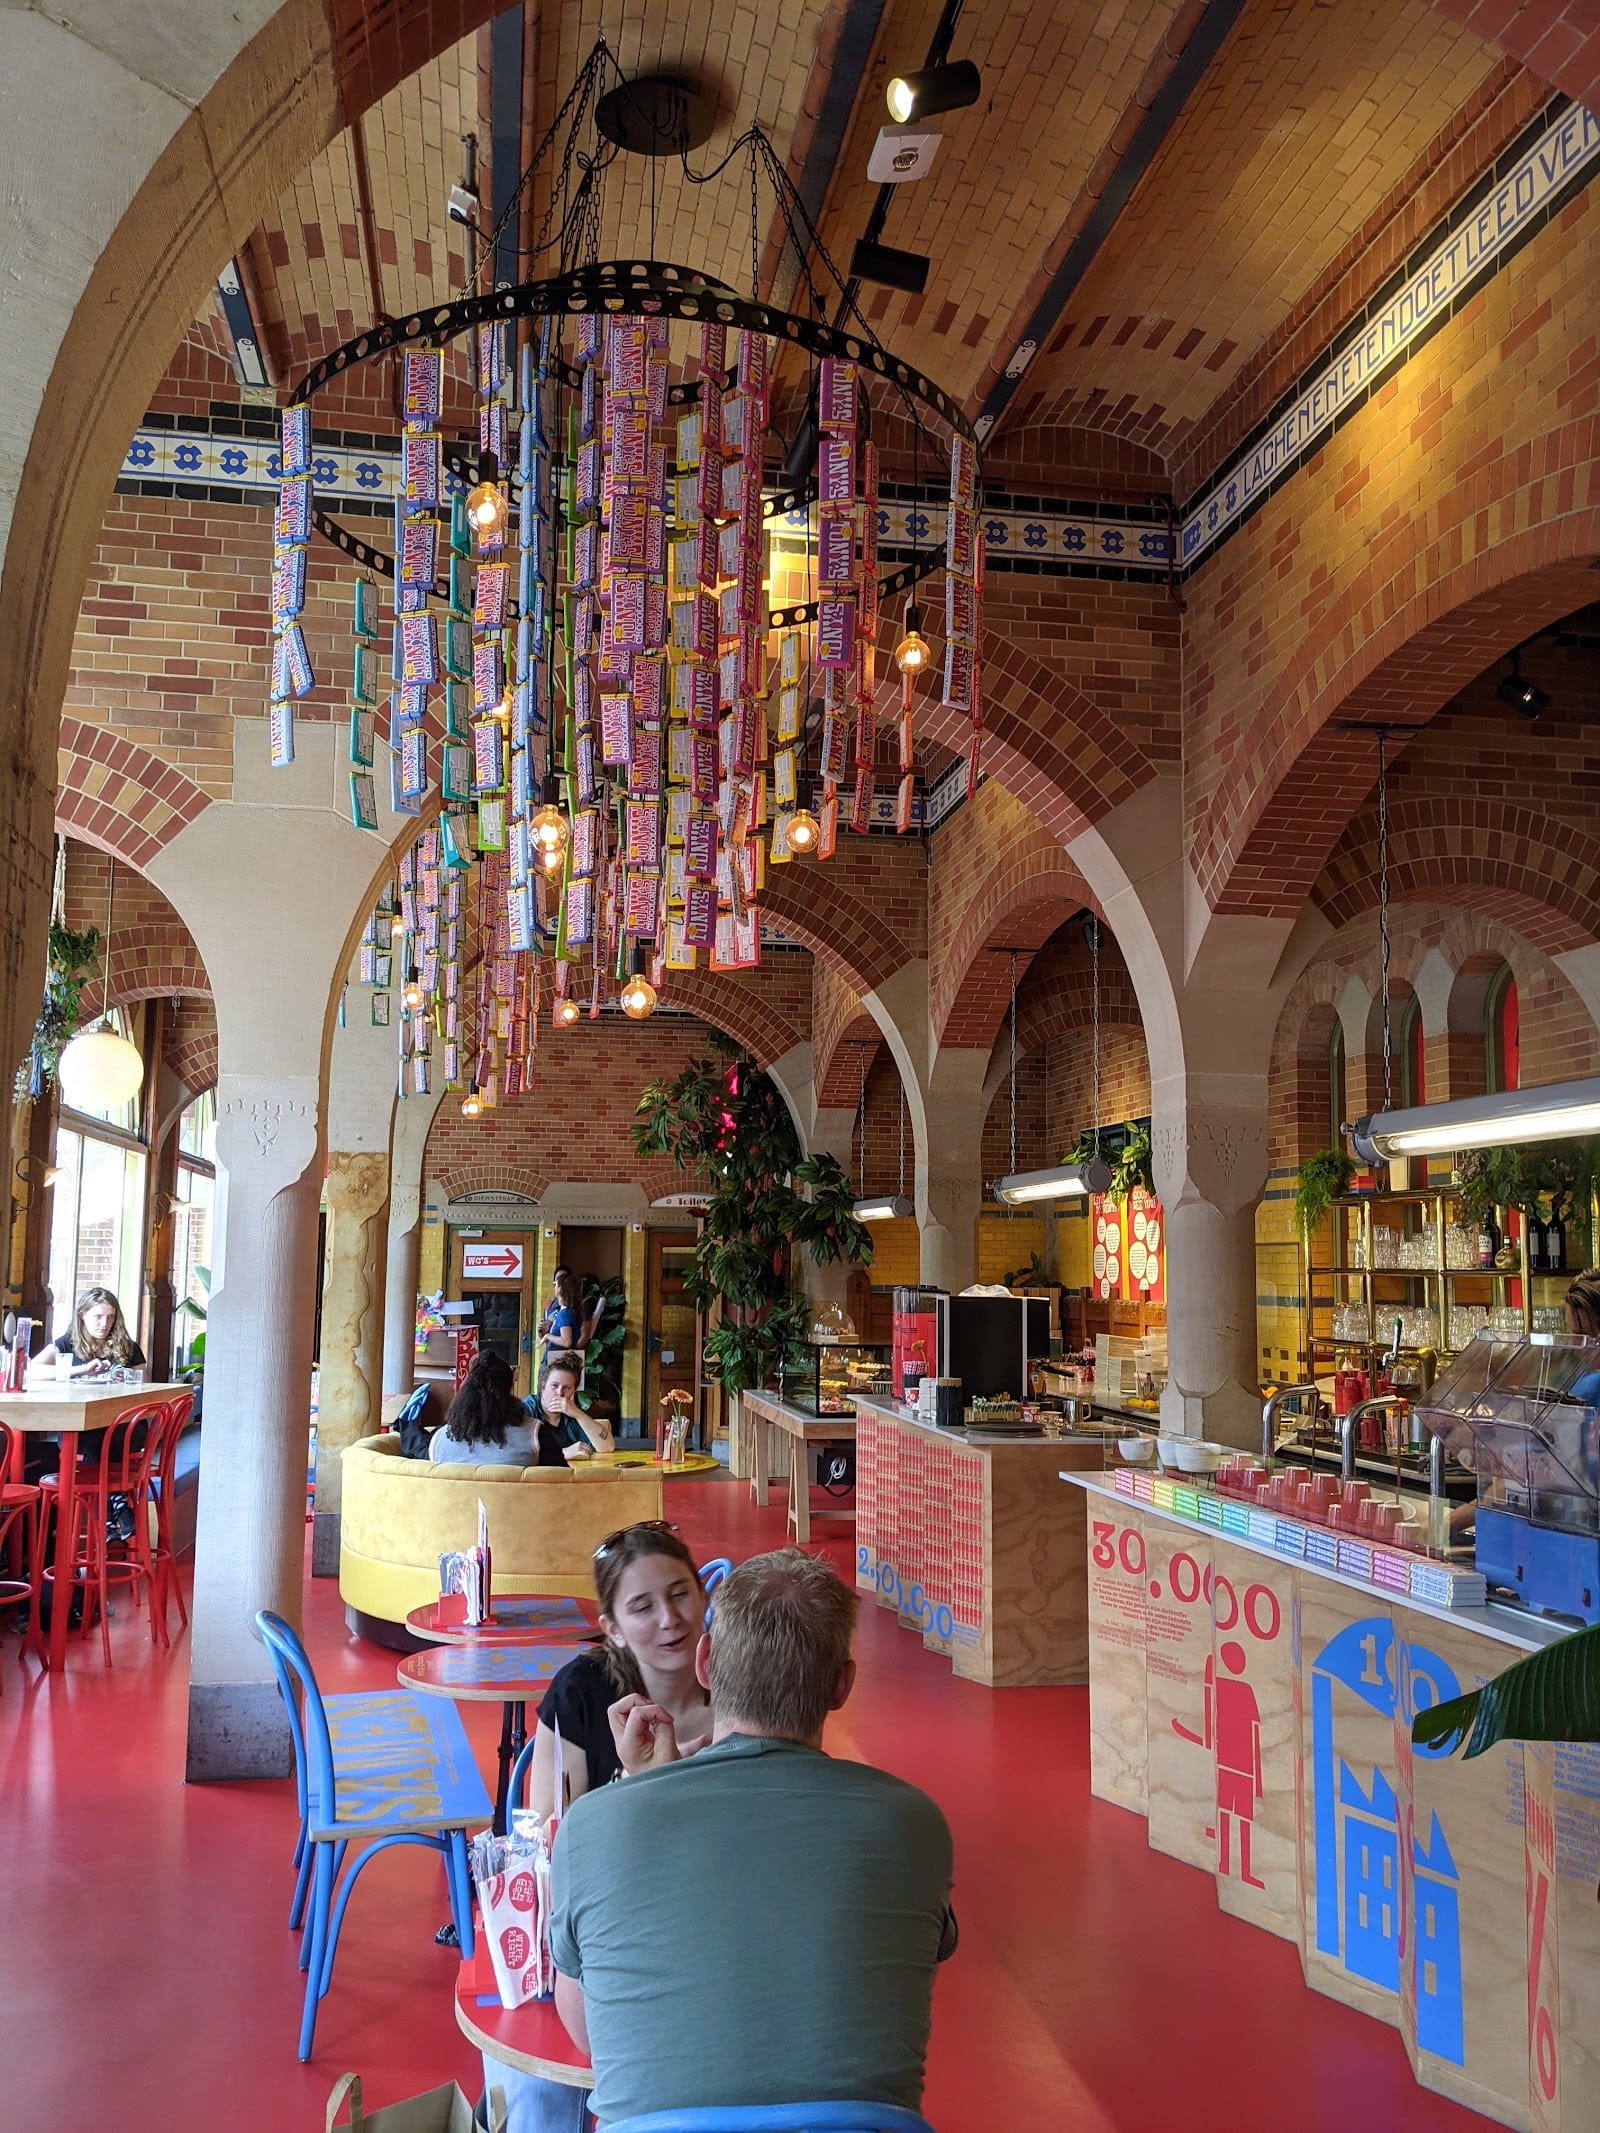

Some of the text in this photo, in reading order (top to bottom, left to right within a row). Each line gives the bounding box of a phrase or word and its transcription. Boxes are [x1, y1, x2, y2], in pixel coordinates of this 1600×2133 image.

[1466, 166, 1534, 267] LEED
[407, 353, 431, 415] TONY'S
[621, 325, 645, 389] TONY'S
[832, 361, 853, 421] TONY'S
[406, 438, 428, 500] TONY'S
[622, 412, 646, 475] TONY'S
[829, 441, 850, 499] TONY'S
[401, 525, 425, 583] TONY'S
[620, 497, 646, 557] TONY'S
[828, 520, 850, 580] TONY'S
[614, 580, 636, 644] TONY'S
[820, 601, 845, 661] TONY'S
[402, 617, 422, 682] TONY'S
[695, 670, 713, 723] TONY'S
[697, 740, 713, 794] TONY'S
[629, 807, 650, 861] TONY'S
[688, 819, 709, 873] TONY'S
[627, 879, 650, 931] TONY'S
[688, 888, 709, 941] TONY'S
[468, 1257, 489, 1266] WC'S
[507, 1930, 517, 1967] RIGHT
[514, 1933, 523, 1962] WIPE
